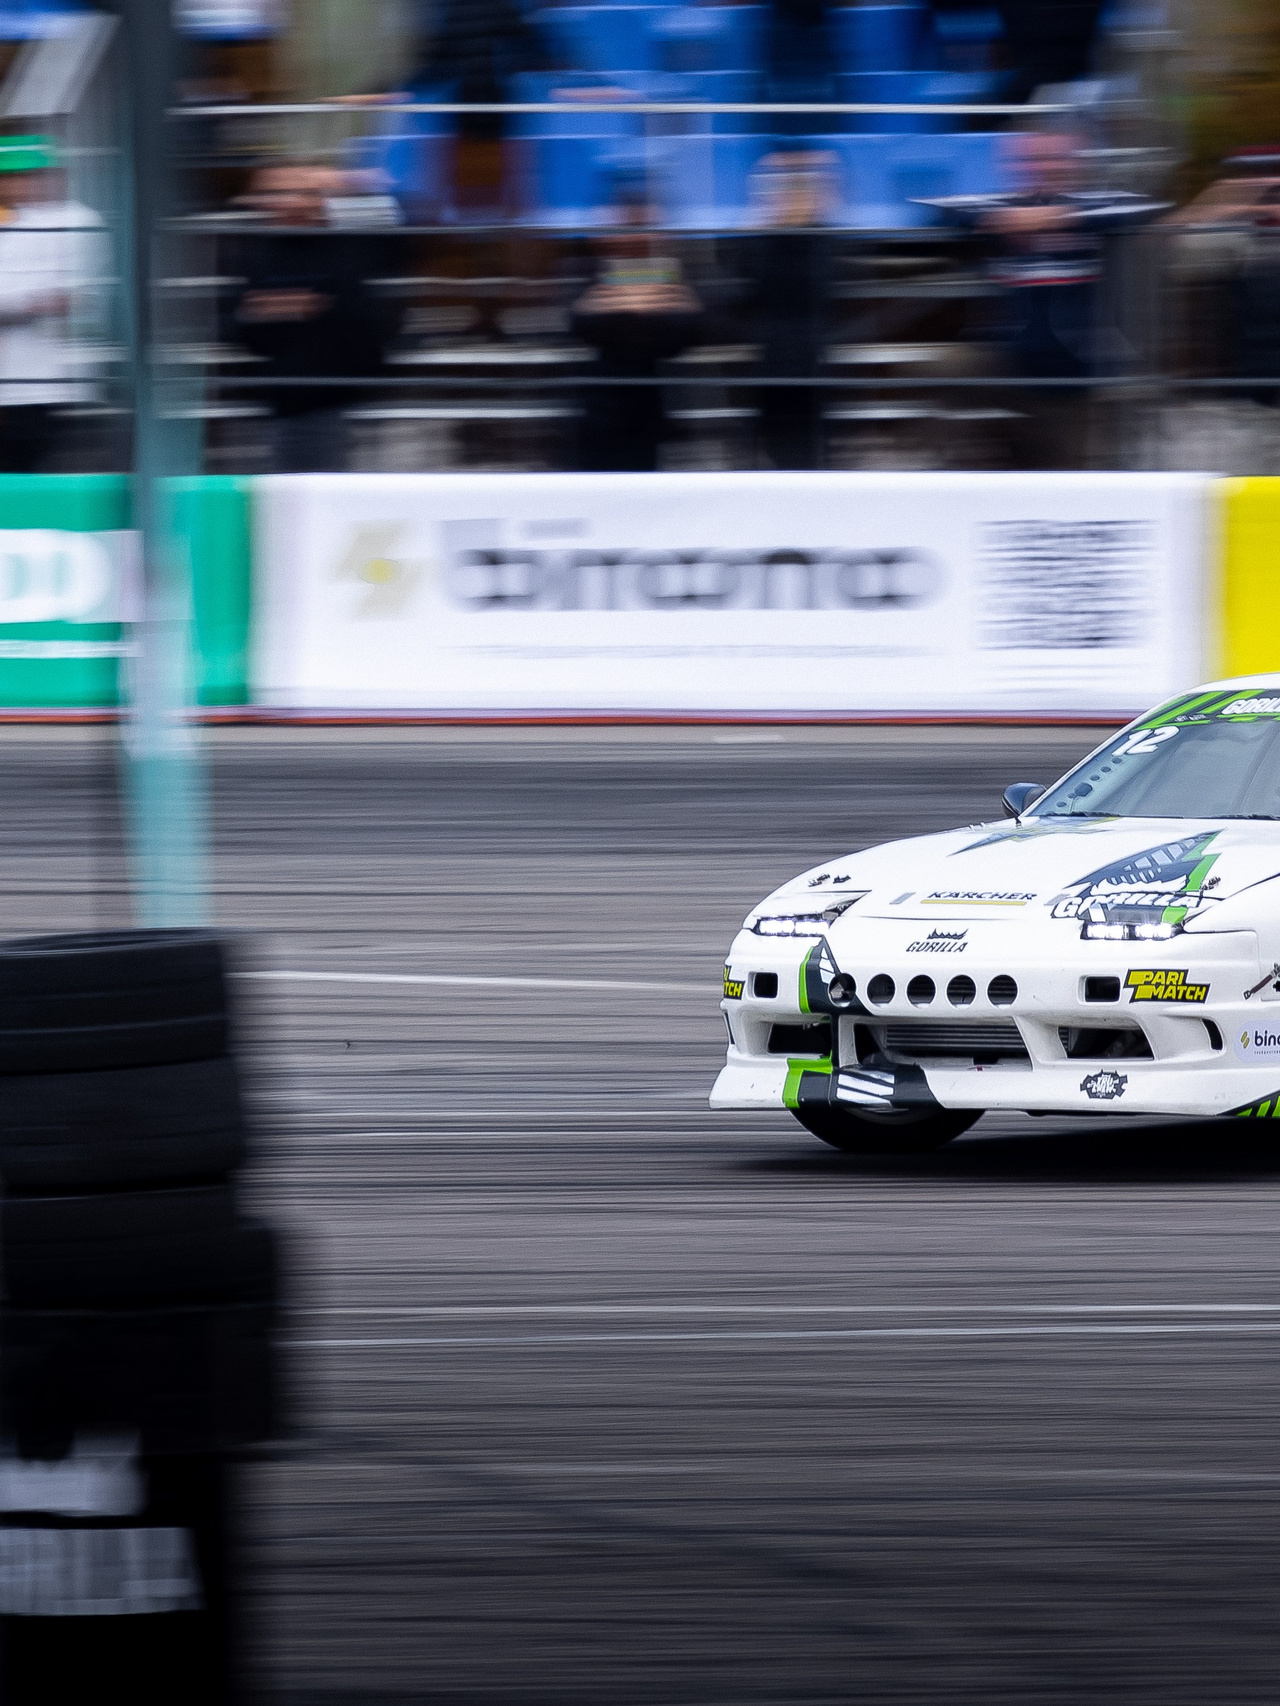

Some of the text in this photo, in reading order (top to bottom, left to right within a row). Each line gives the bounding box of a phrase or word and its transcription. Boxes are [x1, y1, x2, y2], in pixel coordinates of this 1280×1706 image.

[1111, 725, 1180, 756] 12
[905, 941, 969, 952] GORILLA
[1133, 971, 1185, 985] PARI
[1141, 985, 1207, 1000] MATCH
